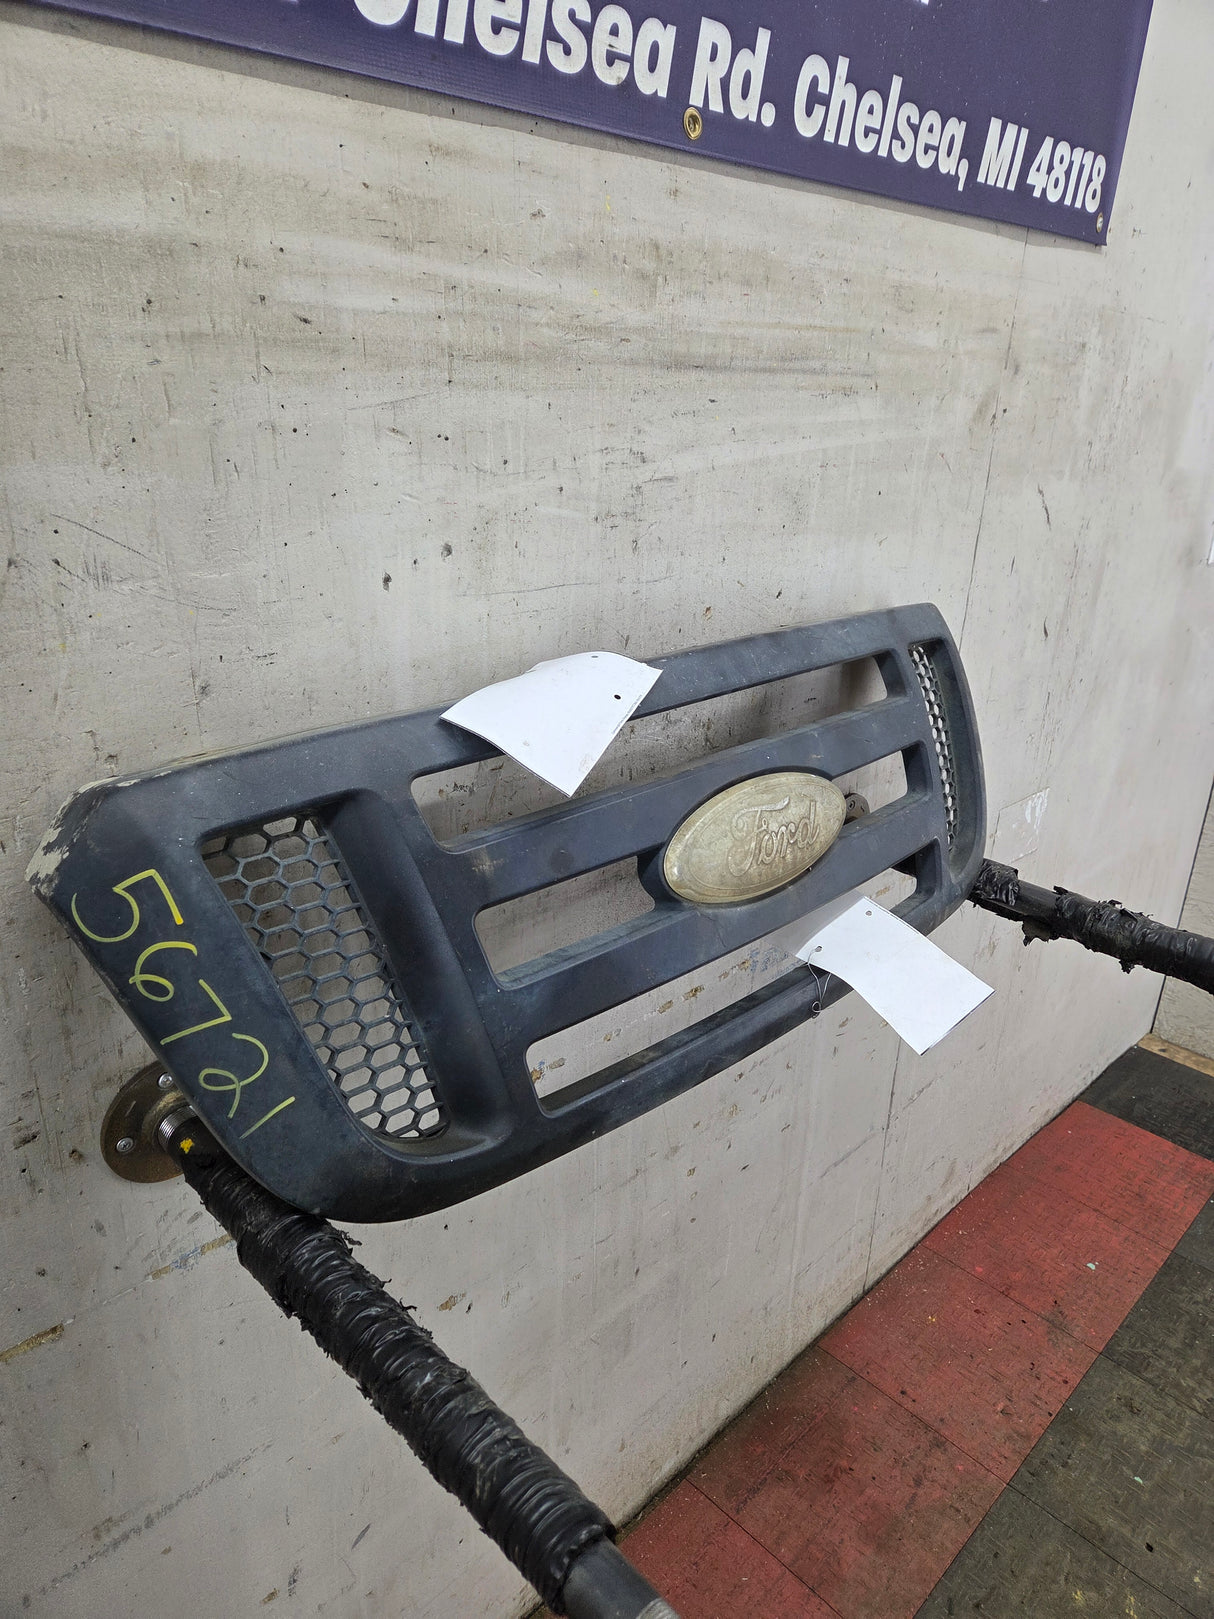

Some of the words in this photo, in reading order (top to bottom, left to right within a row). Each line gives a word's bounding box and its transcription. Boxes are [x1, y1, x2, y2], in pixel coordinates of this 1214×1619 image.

[353, 0, 677, 99] elsea
[688, 16, 776, 128] Rd.
[793, 54, 968, 192] Chelsea,
[976, 116, 1029, 192] MI
[1026, 135, 1108, 214] 48118
[727, 795, 820, 877] Ford
[71, 868, 296, 1139] 56721
